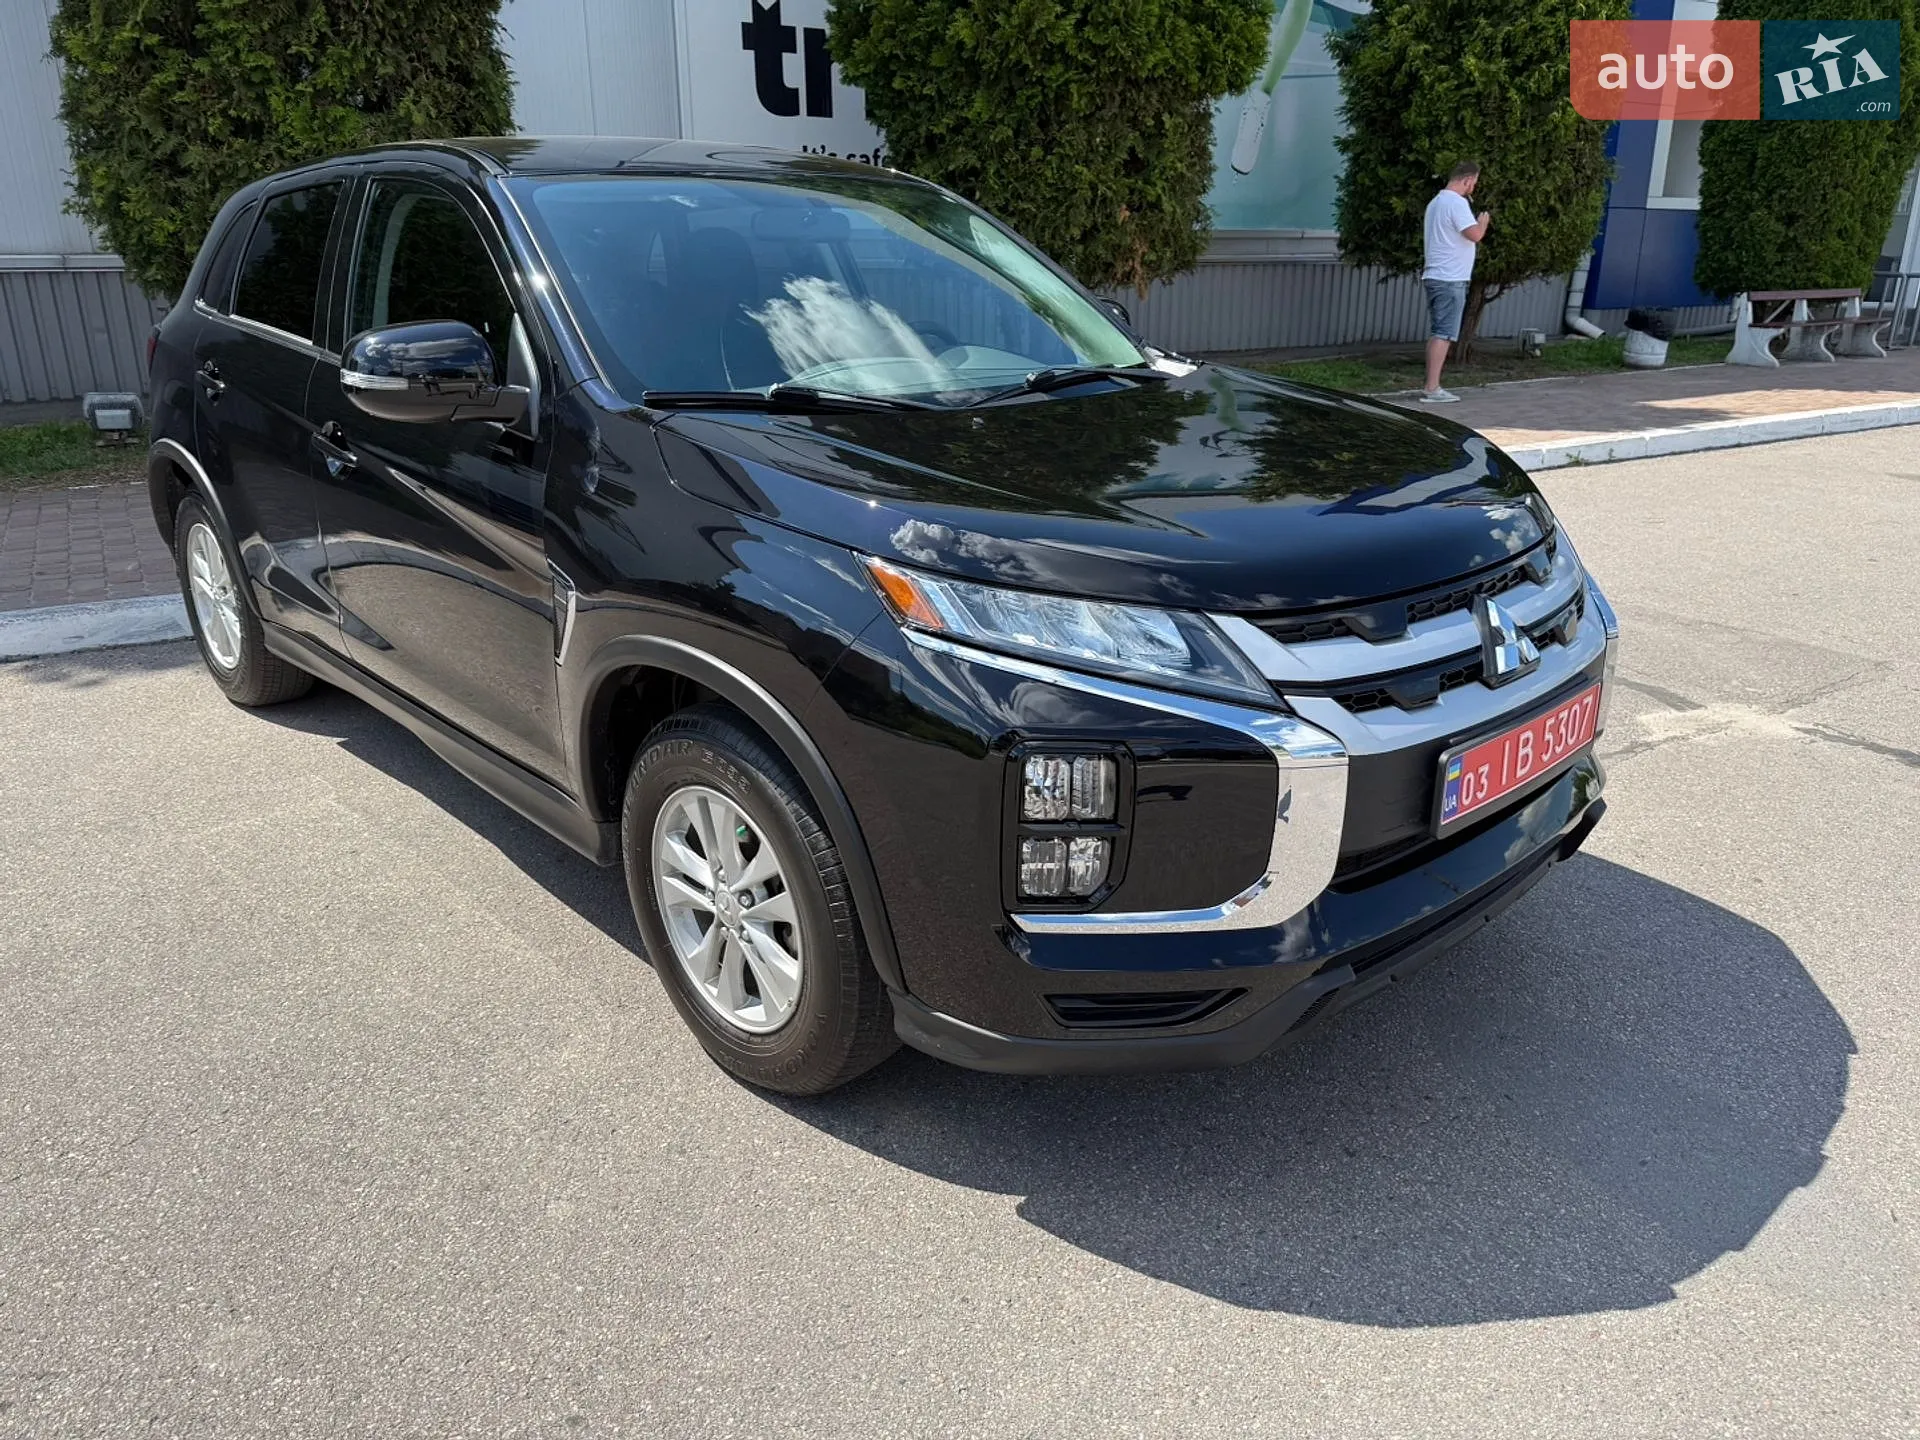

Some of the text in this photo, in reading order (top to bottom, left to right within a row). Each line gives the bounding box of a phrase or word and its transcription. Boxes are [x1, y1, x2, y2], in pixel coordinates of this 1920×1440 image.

[1461, 695, 1593, 806] 03 IB 5307
[1444, 794, 1457, 812] UA
